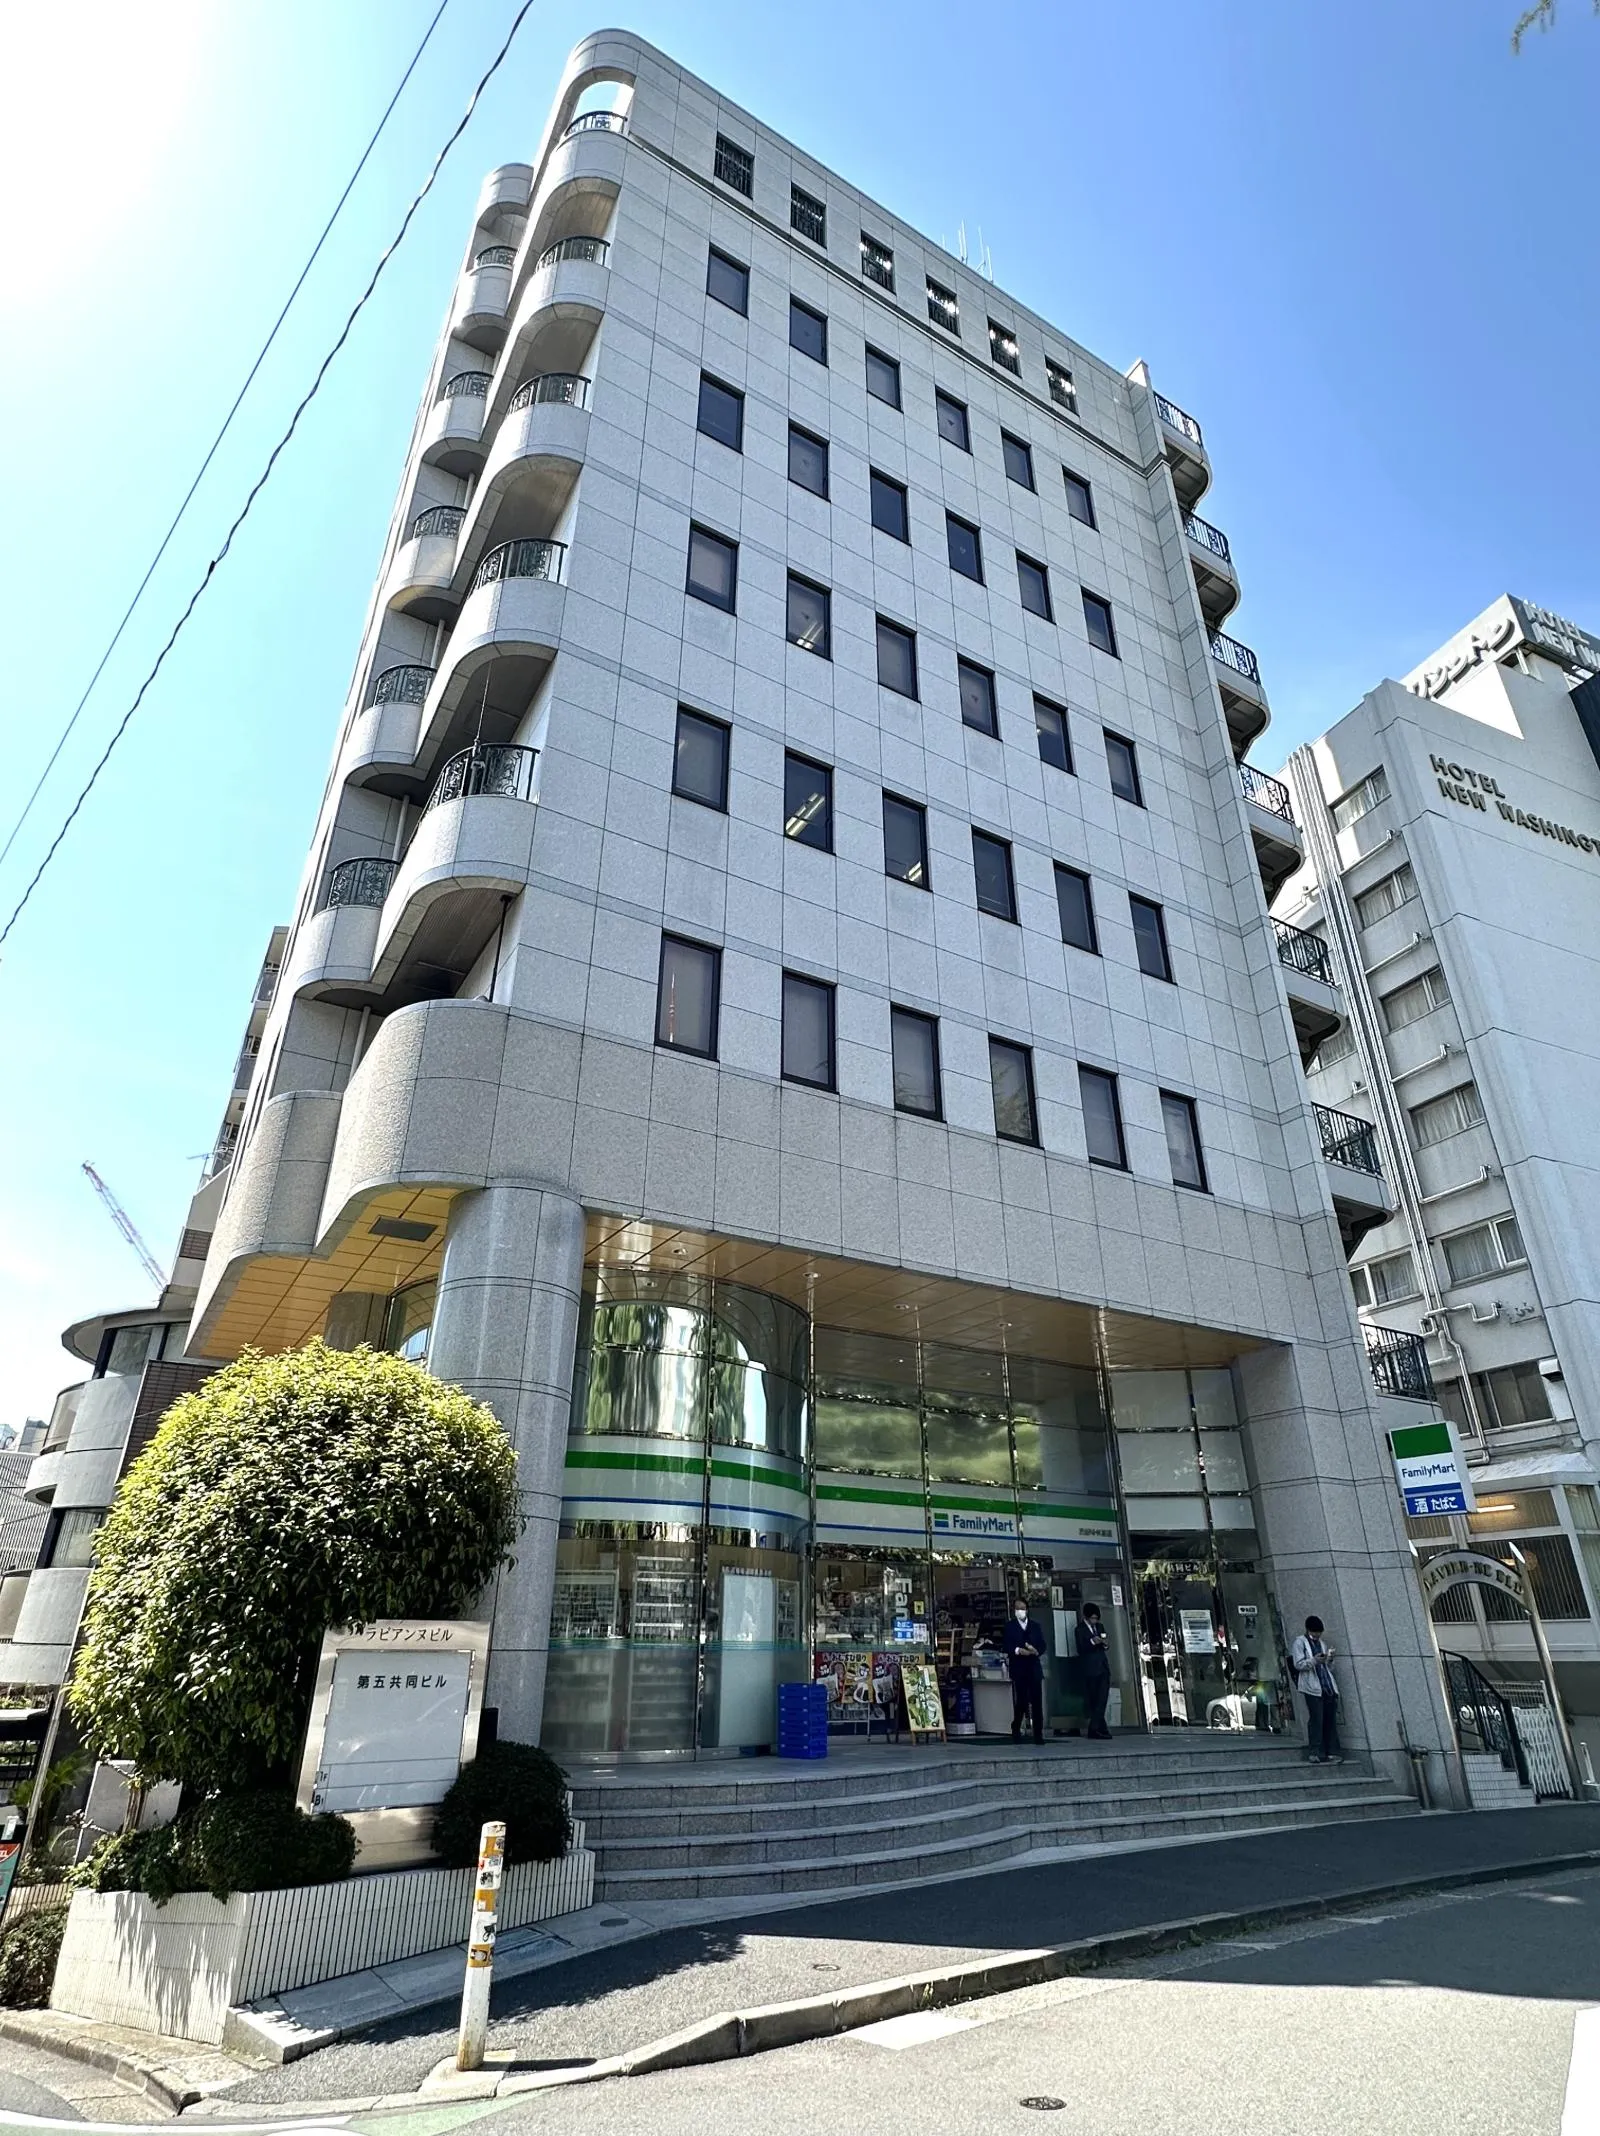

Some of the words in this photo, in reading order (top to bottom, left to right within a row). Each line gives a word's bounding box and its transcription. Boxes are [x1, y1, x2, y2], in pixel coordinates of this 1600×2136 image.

[1523, 599, 1590, 646] HOTEL
[1531, 621, 1577, 659] NEW
[1429, 753, 1506, 799] HOTEL
[1437, 777, 1487, 812] NEW
[1401, 1463, 1456, 1479] FamilyMart
[1415, 1497, 1429, 1513] 酒
[1430, 1496, 1459, 1511] たばこ
[952, 1514, 1014, 1533] FamilyMart
[366, 1626, 454, 1642] ラビアンヌビル
[356, 1674, 447, 1689] 第五共同ビル
